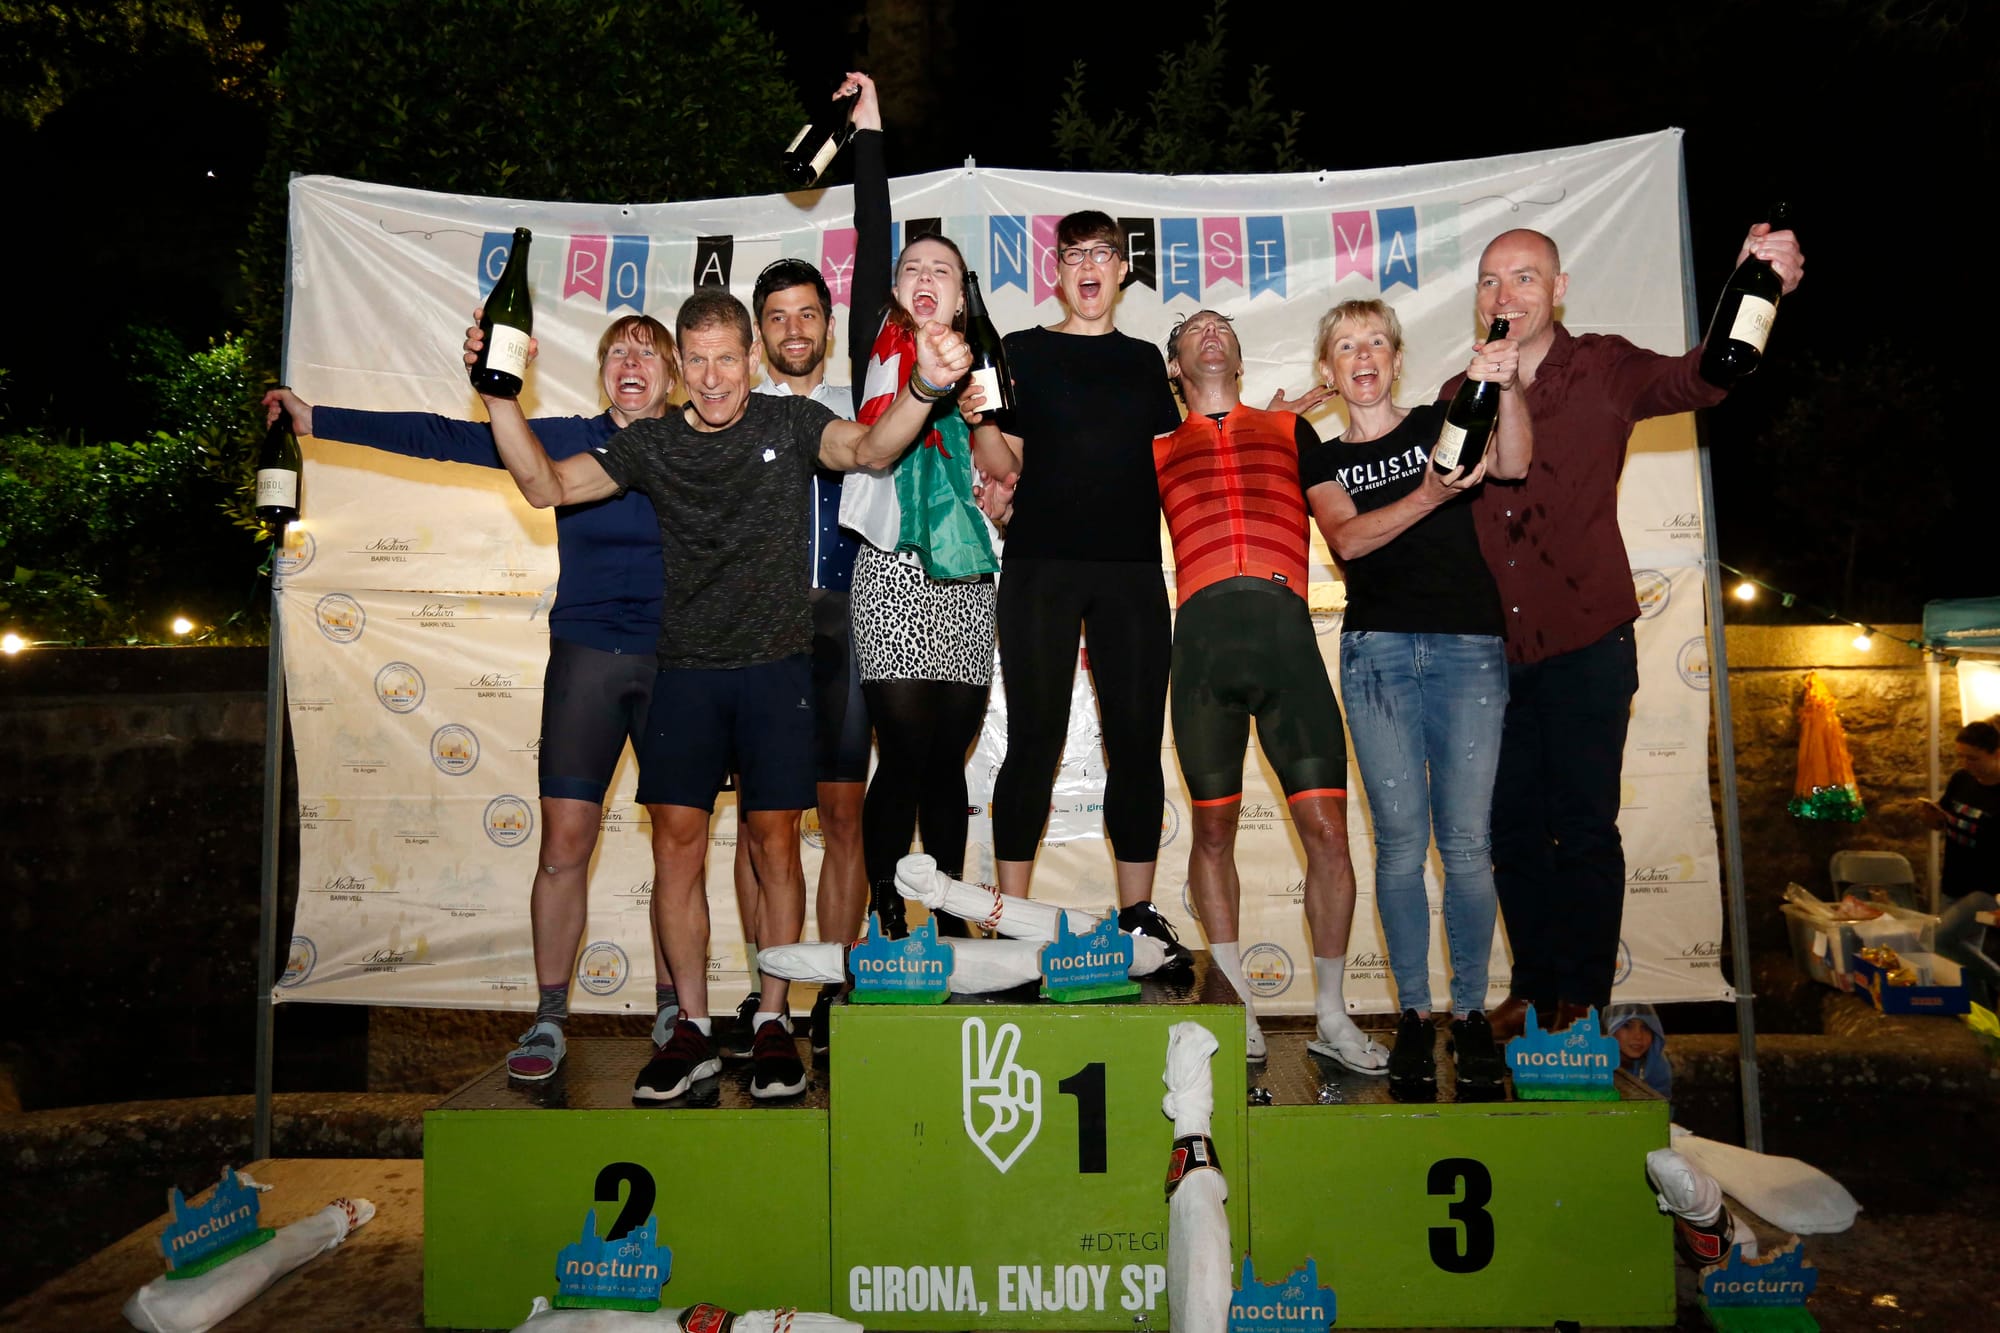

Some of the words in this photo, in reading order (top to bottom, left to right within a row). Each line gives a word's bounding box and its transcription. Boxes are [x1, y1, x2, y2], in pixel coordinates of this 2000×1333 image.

[1365, 480, 1387, 490] NEEDED
[365, 537, 418, 551] Nocturn
[411, 604, 464, 617] Nocturn
[470, 673, 520, 687] Nocturn
[1087, 803, 1104, 812] giro
[325, 875, 375, 890] Nocturn
[859, 956, 942, 973] nocturn
[1050, 951, 1124, 970] nocturn
[1516, 1049, 1608, 1067] nocturn
[1059, 1062, 1107, 1173] 1
[594, 1162, 657, 1242] 2
[1426, 1157, 1495, 1273] 3
[172, 1205, 251, 1251] nocturn
[1080, 1232, 1164, 1251] #DTEGI
[566, 1259, 658, 1279] nocturn
[849, 1265, 988, 1315] GIRONA,
[999, 1264, 1111, 1312] ENJOY
[1120, 1264, 1166, 1311] SP
[1713, 1279, 1804, 1293] nocturn
[1232, 1302, 1324, 1320] nocturn
